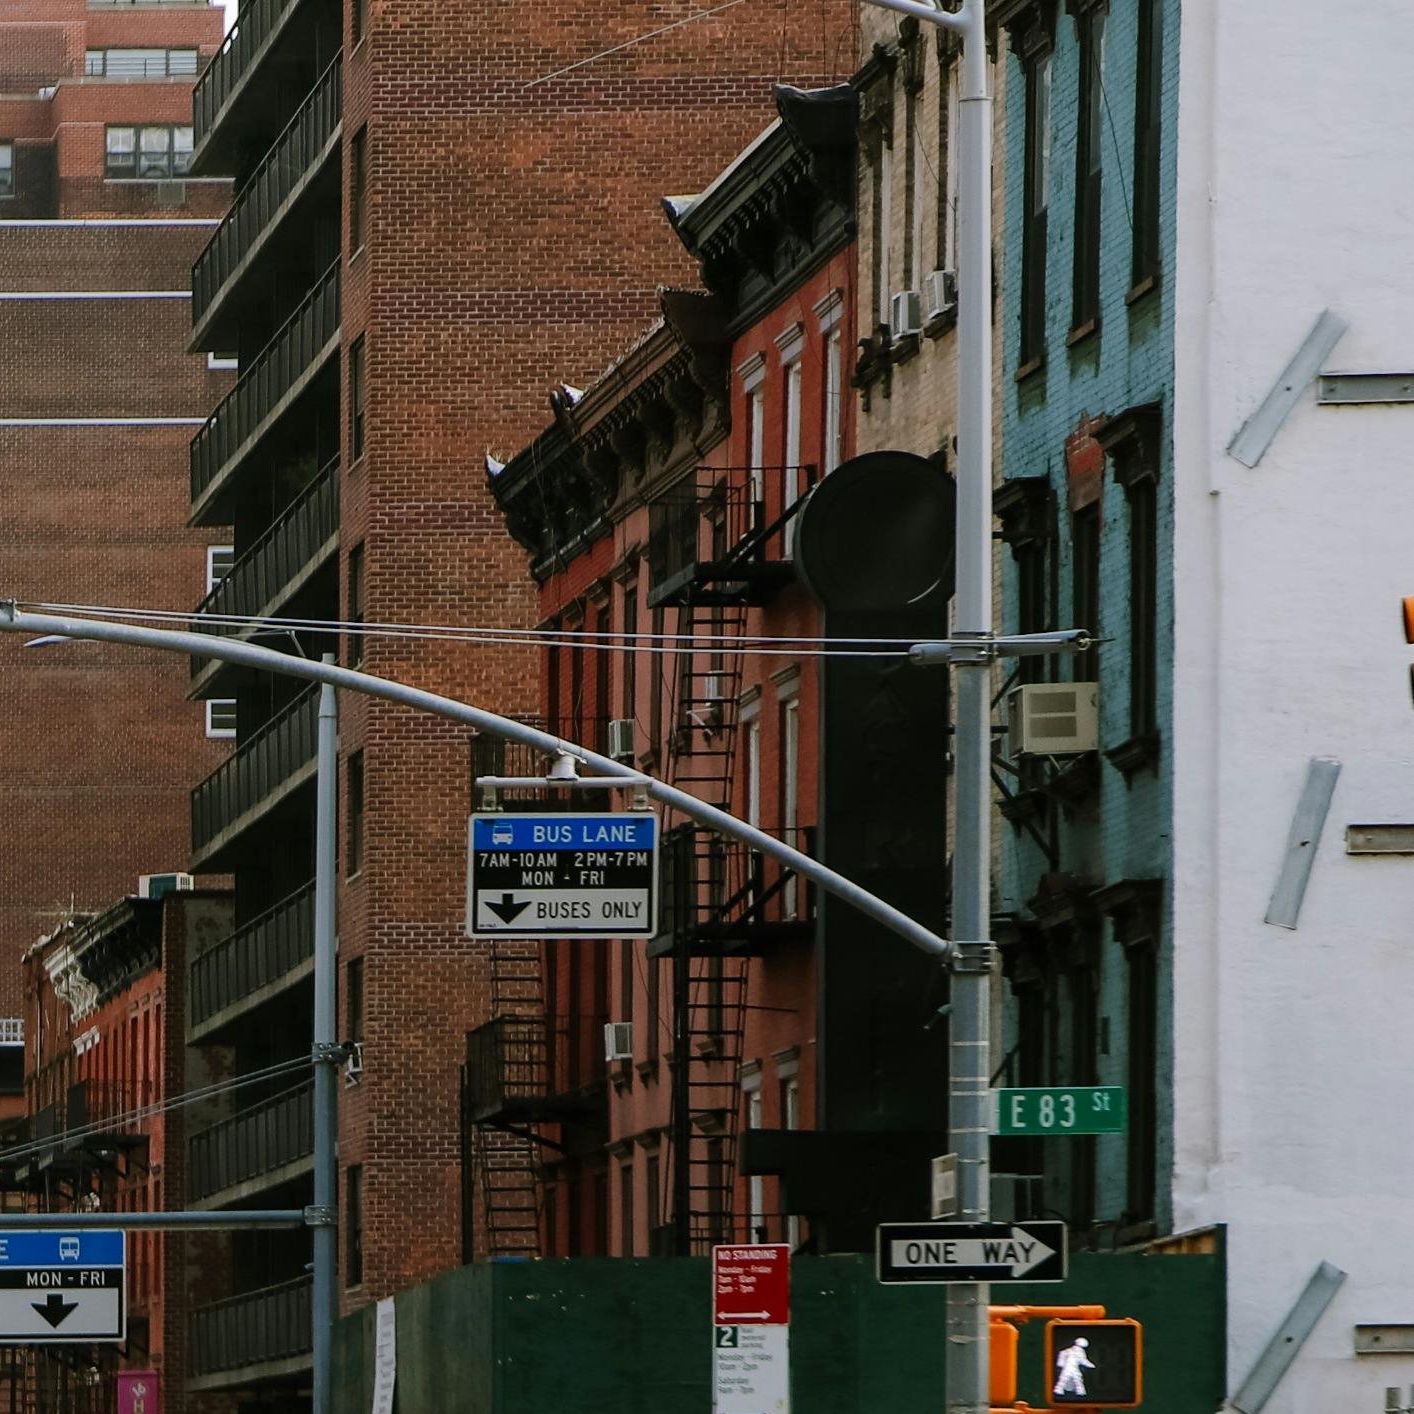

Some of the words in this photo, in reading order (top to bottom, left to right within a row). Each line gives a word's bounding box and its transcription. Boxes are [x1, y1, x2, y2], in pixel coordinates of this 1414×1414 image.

[533, 825, 572, 843] BUS
[582, 825, 636, 843] LANE
[522, 871, 554, 886] MON
[580, 871, 605, 886] FRI
[537, 901, 591, 919] BUSES
[602, 901, 642, 919] ONLY
[1011, 1095, 1027, 1128] E
[1039, 1094, 1076, 1128] 83
[1092, 1092, 1111, 1111] St
[717, 1250, 732, 1260] NO
[733, 1249, 778, 1260] STANDING
[905, 1242, 958, 1265] ONE
[981, 1241, 1037, 1264] WAY
[27, 1271, 62, 1287] MON
[79, 1271, 106, 1286] FRI
[720, 1326, 734, 1346] 2
